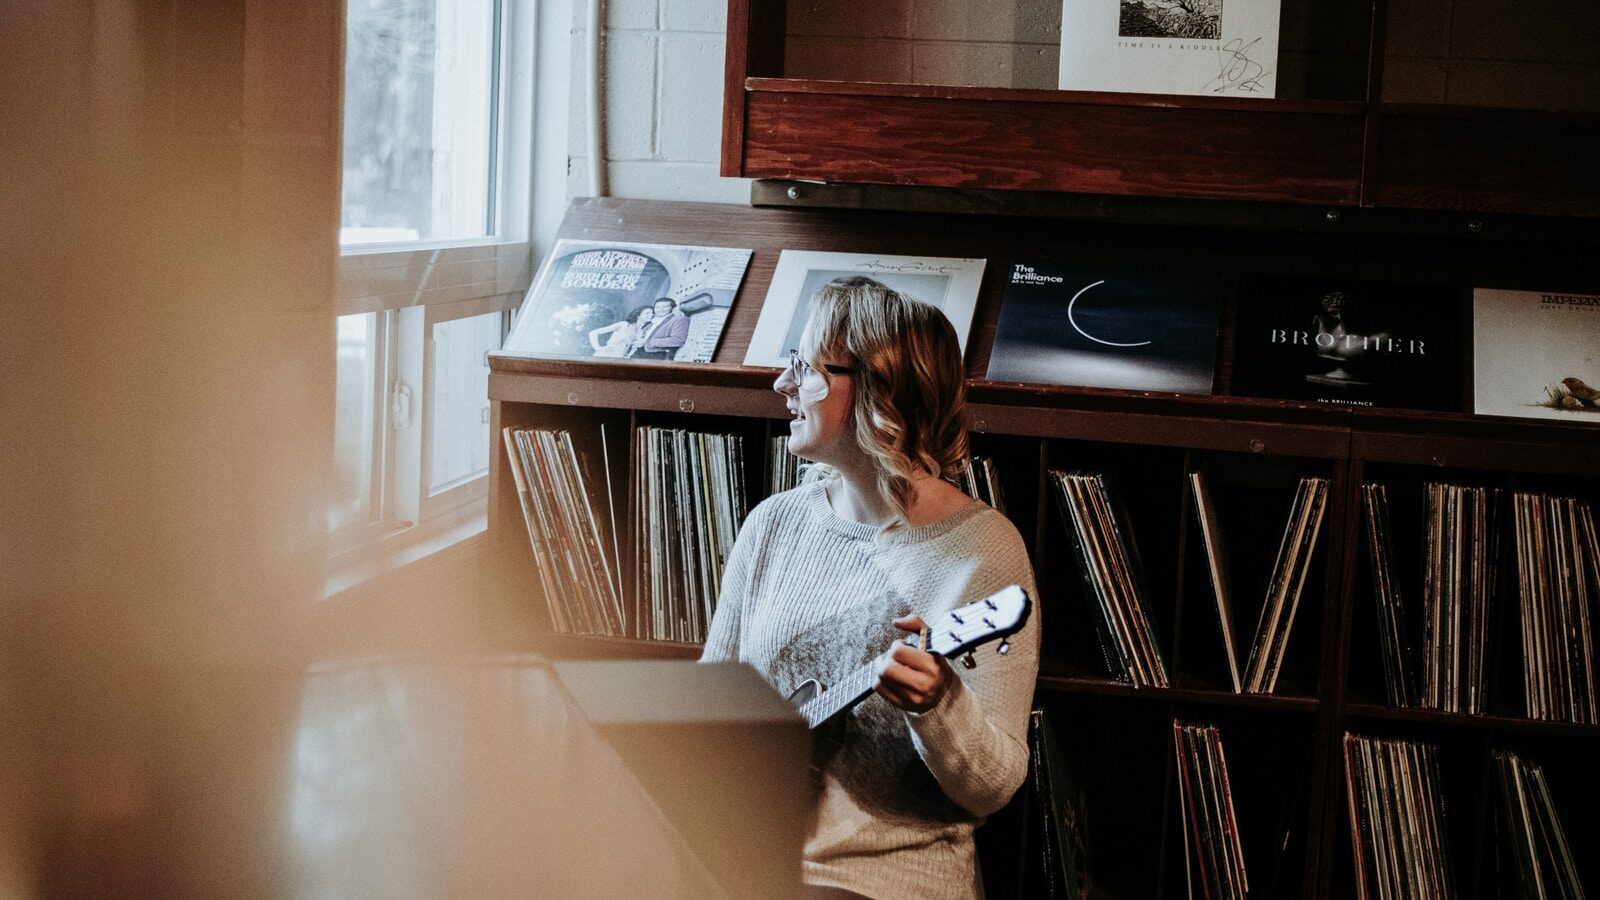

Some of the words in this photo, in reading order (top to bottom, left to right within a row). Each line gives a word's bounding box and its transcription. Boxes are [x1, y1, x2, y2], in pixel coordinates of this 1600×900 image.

[1014, 264, 1035, 273] The
[1013, 272, 1063, 283] Brilliance
[560, 279, 637, 291] BORDER
[1271, 329, 1426, 355] BROTHER
